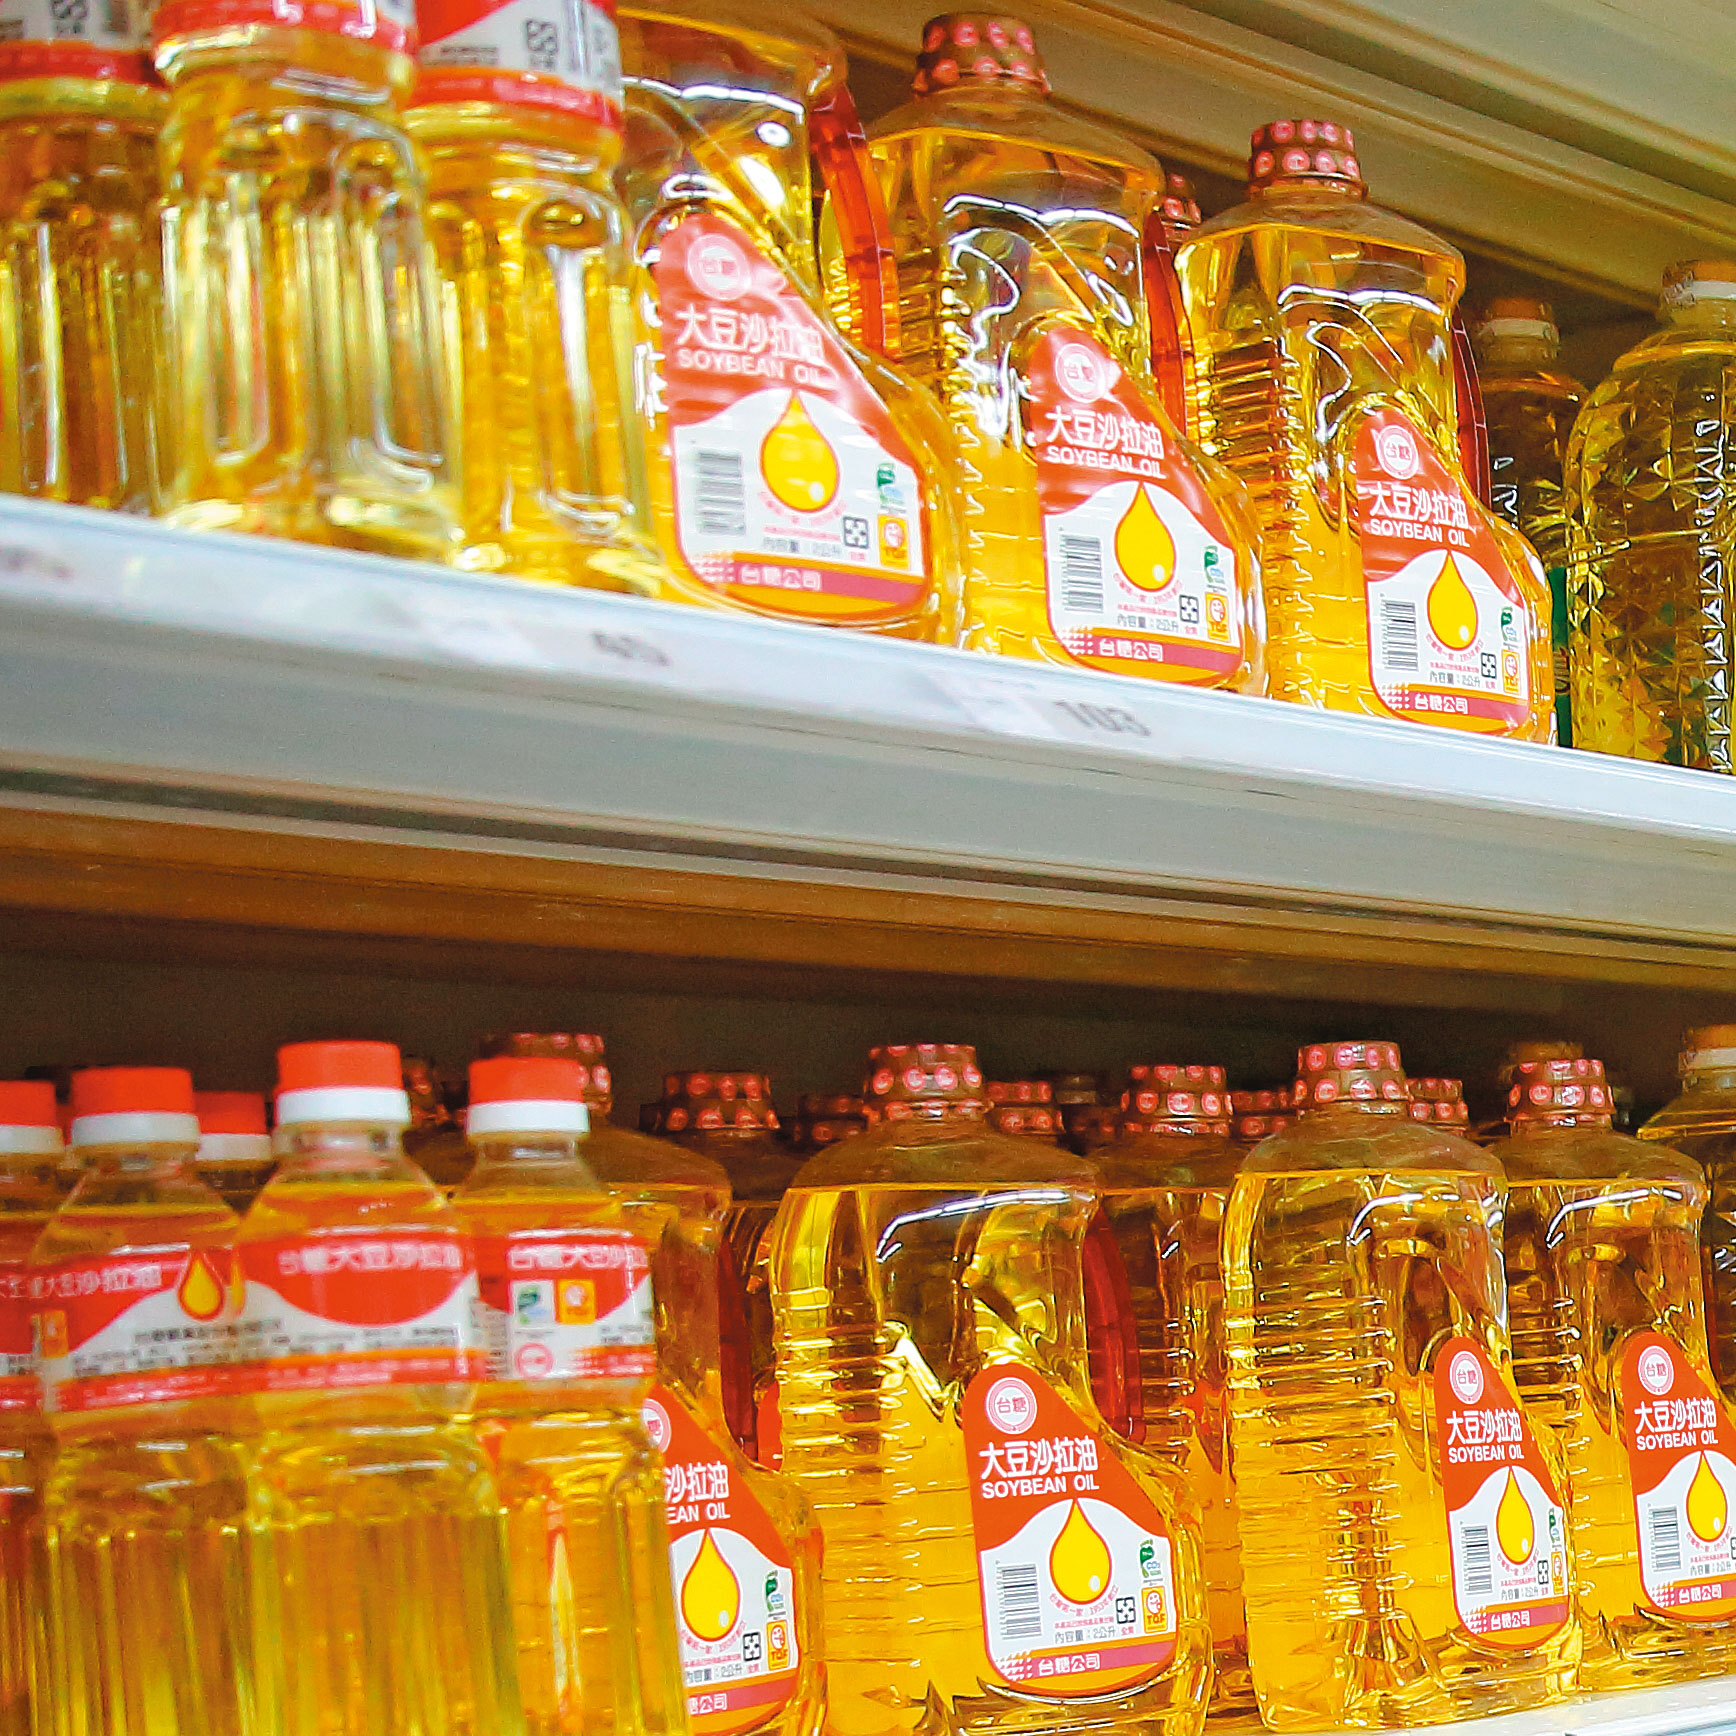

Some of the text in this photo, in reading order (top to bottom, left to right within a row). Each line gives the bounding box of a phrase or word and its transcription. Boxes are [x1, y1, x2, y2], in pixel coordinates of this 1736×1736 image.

[1045, 404, 1166, 460] 大豆沙拉油
[1047, 446, 1132, 475] SOYBEAN
[1369, 486, 1469, 530] 大豆沙拉油
[1370, 518, 1470, 548] SOYBEAN OIL
[996, 1395, 1027, 1415] 台糖
[1634, 1396, 1717, 1435] 大豆沙拉油
[1446, 1407, 1523, 1446] 大豆沙拉油
[1636, 1429, 1719, 1451] SOYBEAN OIL
[979, 1435, 1099, 1480] 大豆沙拉油
[1448, 1444, 1525, 1464] SOYBEAN OIL
[664, 1460, 730, 1502] 沙拉油
[981, 1473, 1101, 1500] SOYBEAN OIL
[706, 1502, 731, 1521] OIL
[1490, 1610, 1531, 1632] 台糖公司
[1038, 1651, 1102, 1678] 台糖公司
